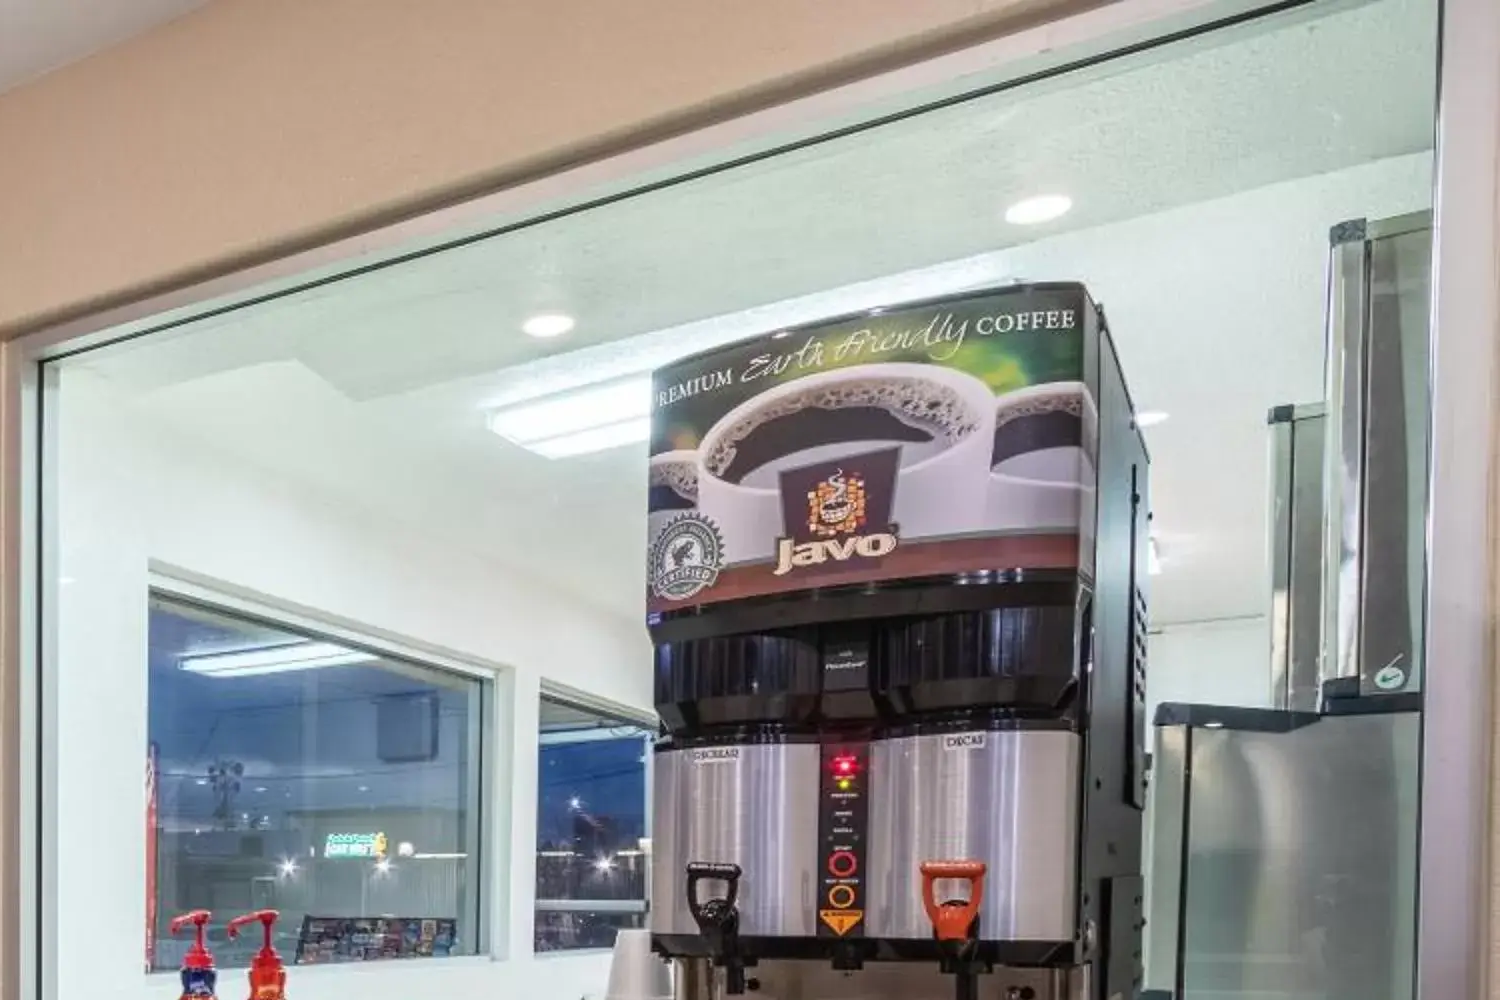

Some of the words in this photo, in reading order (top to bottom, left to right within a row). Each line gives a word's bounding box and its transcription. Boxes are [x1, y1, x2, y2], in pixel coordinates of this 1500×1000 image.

[740, 335, 825, 383] Earth
[834, 312, 968, 361] Friendly
[976, 309, 1076, 335] COFFEE
